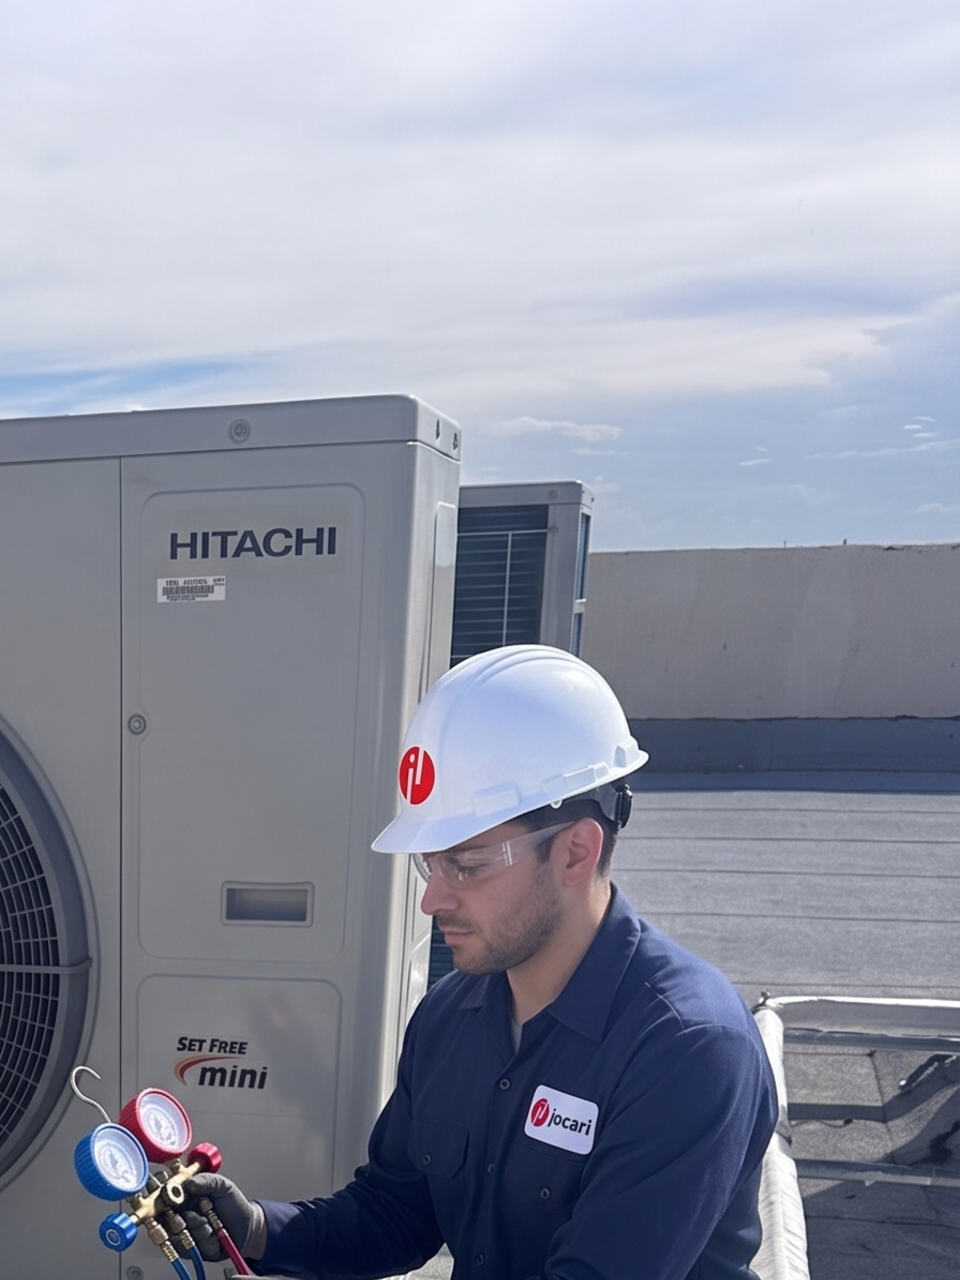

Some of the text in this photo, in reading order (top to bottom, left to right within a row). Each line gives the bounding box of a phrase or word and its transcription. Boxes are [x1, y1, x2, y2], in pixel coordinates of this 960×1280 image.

[169, 527, 337, 560] HITACHI
[176, 1036, 248, 1055] SET FREE
[198, 1065, 268, 1090] mini
[547, 1108, 592, 1136] jocari
